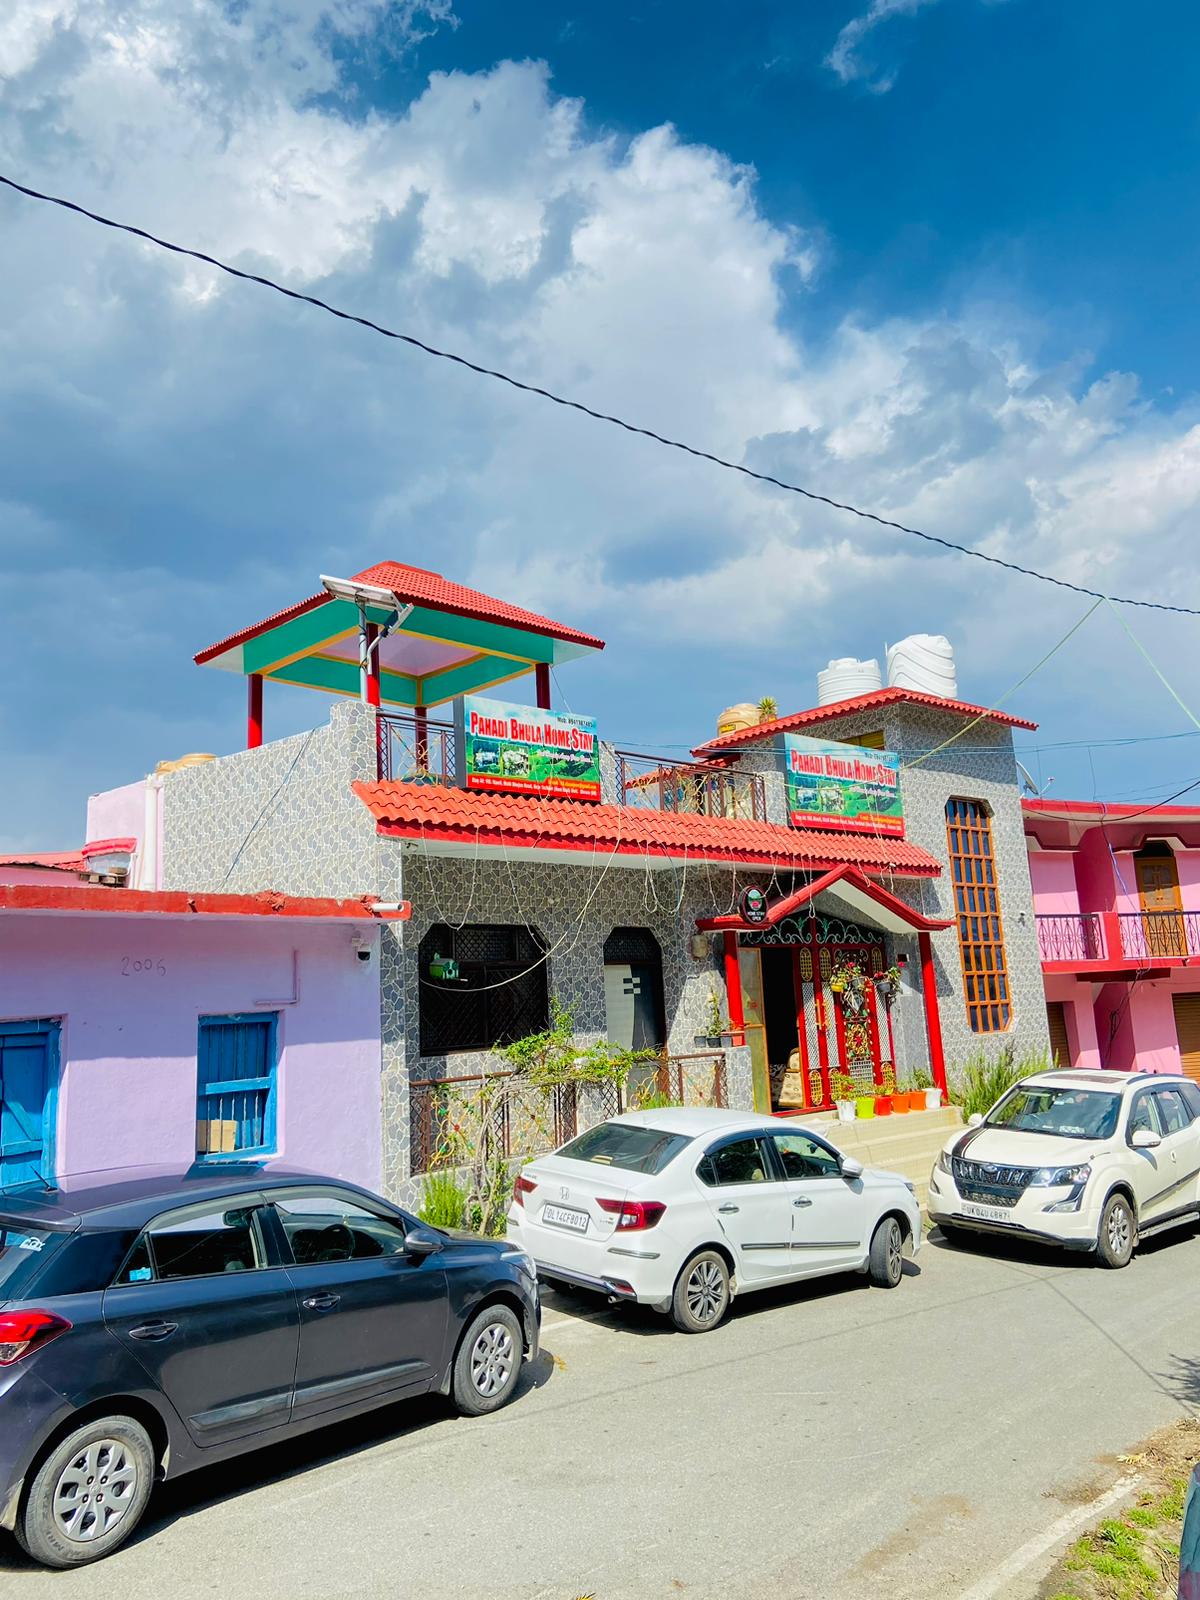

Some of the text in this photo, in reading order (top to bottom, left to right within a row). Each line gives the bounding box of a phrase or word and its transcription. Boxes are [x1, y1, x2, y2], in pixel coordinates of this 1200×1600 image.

[471, 712, 594, 751] PAHADI BHULA HOME STAY
[791, 750, 824, 775] PAHADI
[825, 755, 853, 779] BHULA
[854, 759, 877, 782] HOME
